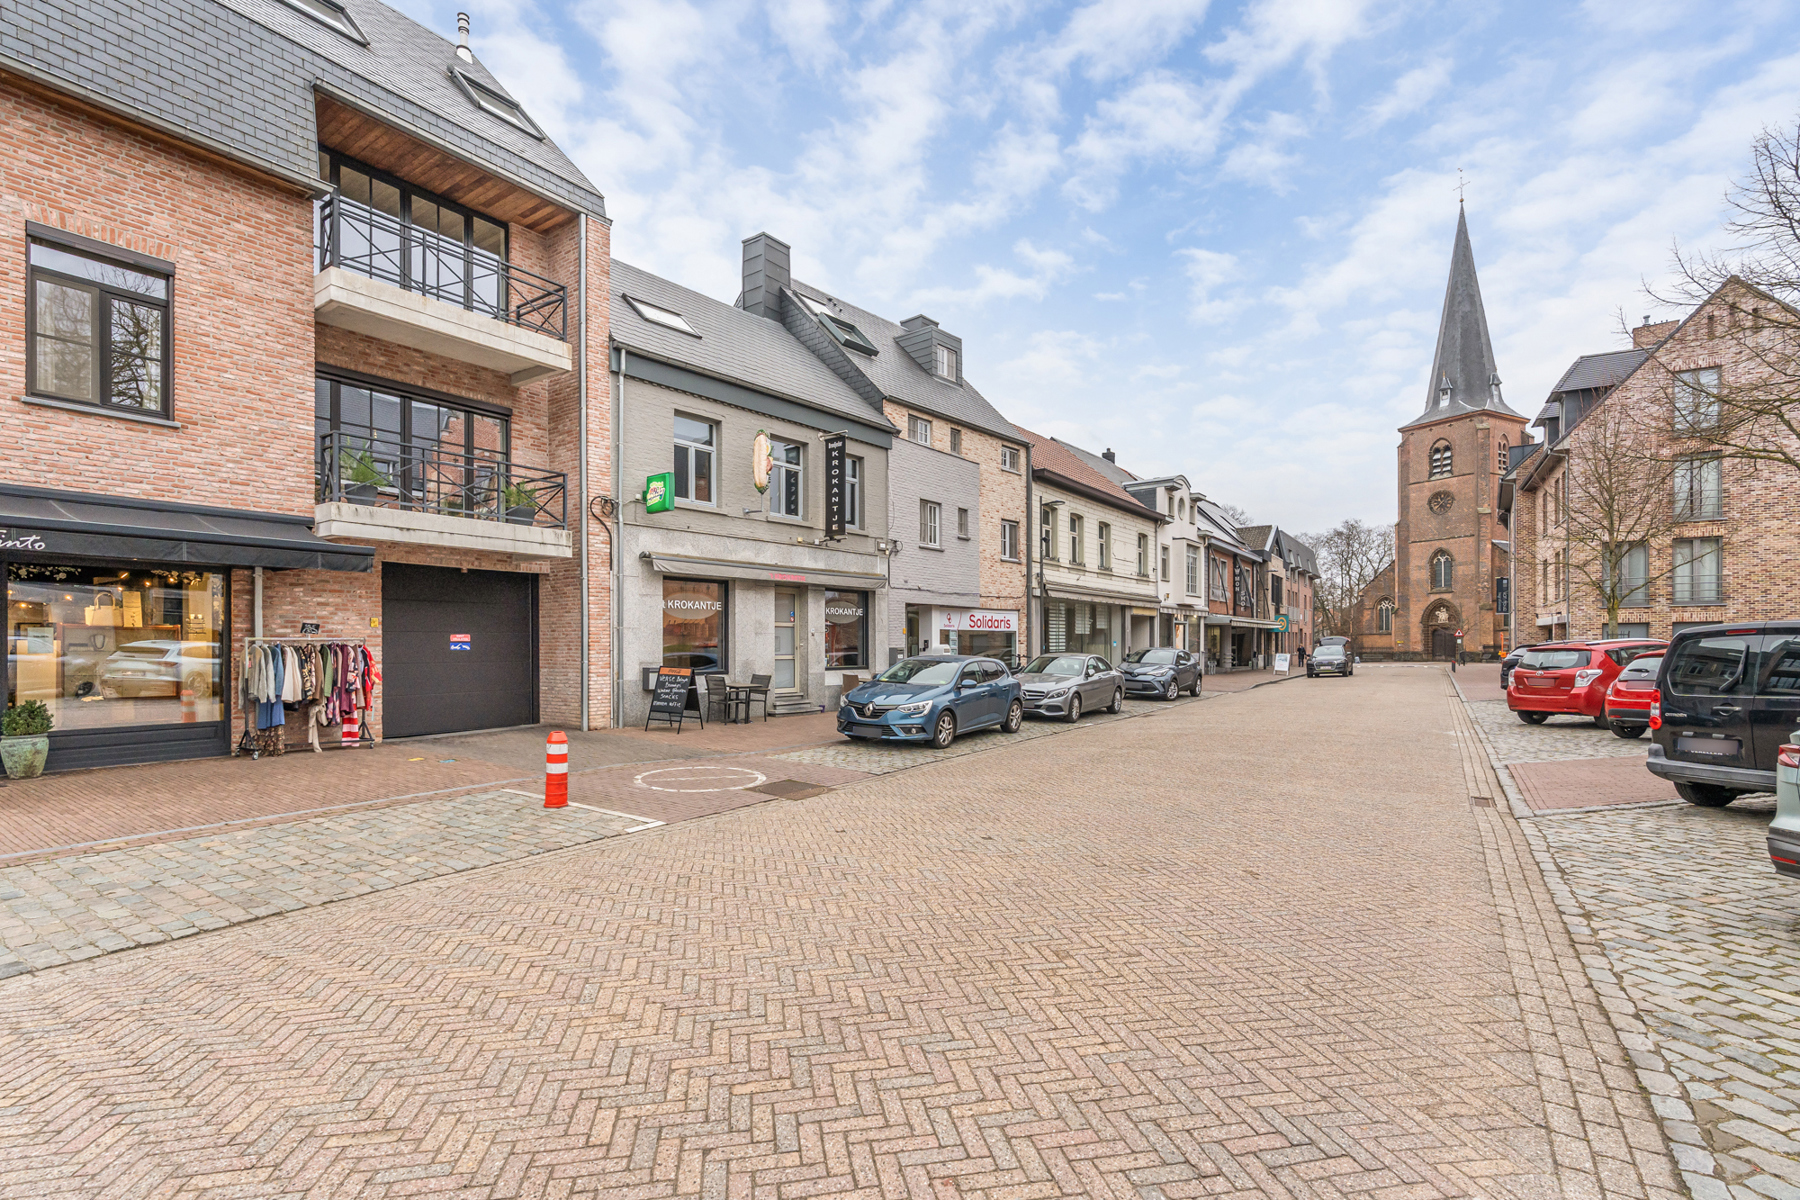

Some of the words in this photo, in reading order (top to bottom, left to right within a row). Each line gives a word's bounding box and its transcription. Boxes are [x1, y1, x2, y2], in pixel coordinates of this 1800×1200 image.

[831, 450, 840, 531] KROKANTJE
[667, 600, 723, 611] KROKANTJE
[825, 607, 864, 616] KROKANTJE
[968, 613, 1011, 629] Solidaris
